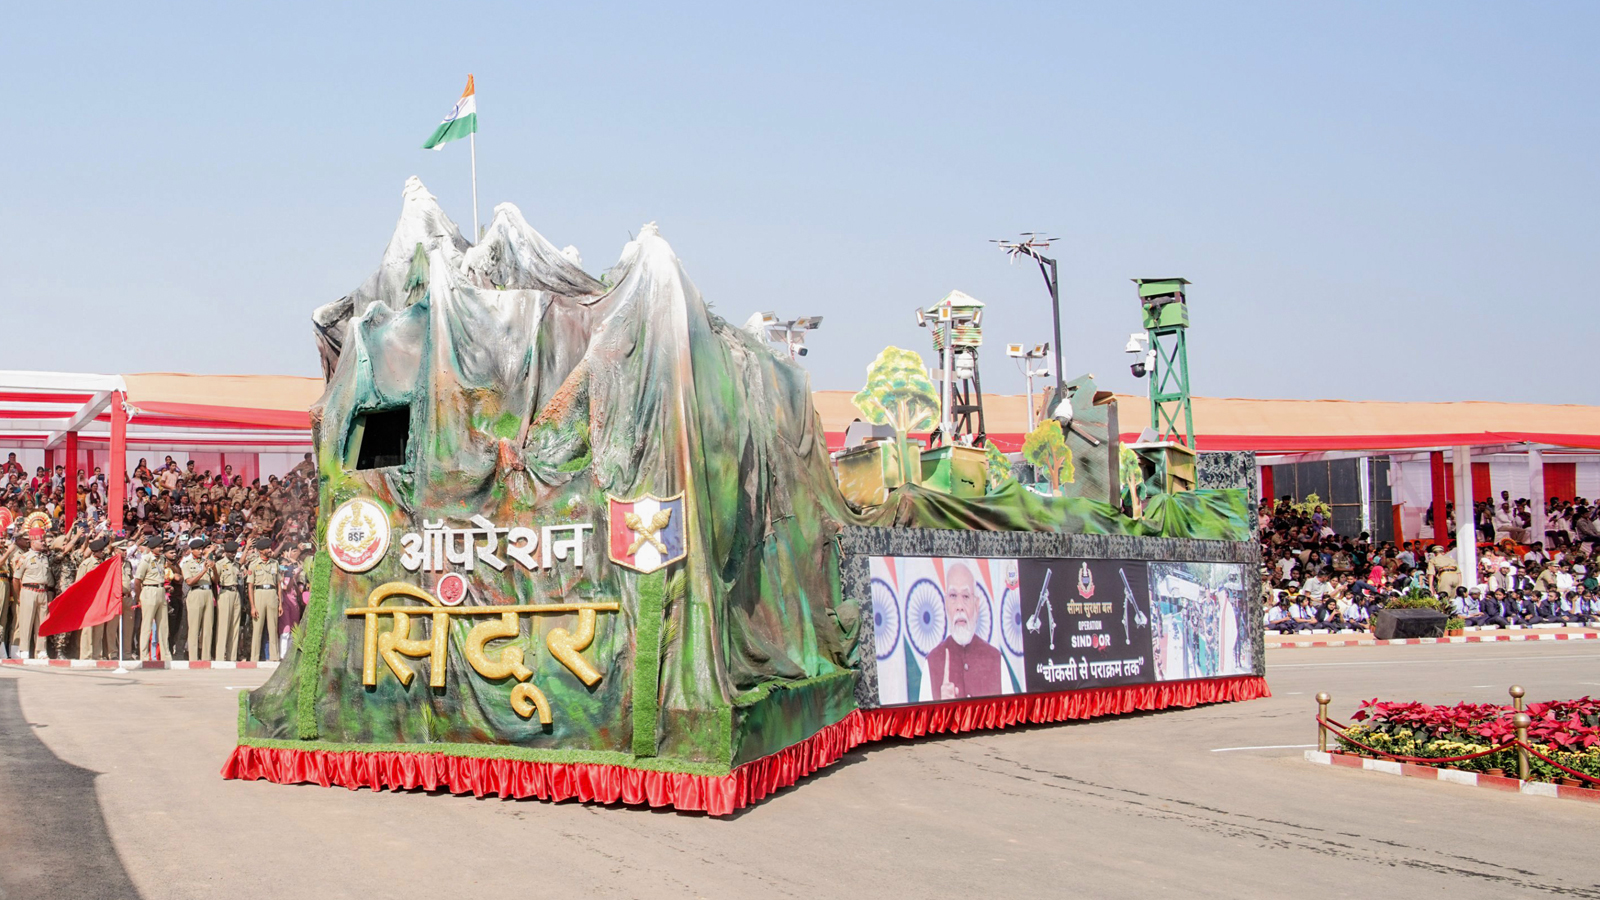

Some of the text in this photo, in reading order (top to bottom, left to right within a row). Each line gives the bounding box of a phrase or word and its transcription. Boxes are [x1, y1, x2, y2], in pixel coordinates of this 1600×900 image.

[348, 532, 365, 542] BSF
[400, 514, 592, 571] ऑपरेशन
[1067, 599, 1083, 614] सीमा
[1084, 602, 1101, 618] सुरक्षा
[1078, 620, 1102, 630] OPERATION
[344, 572, 619, 724] सिंदूर
[1079, 655, 1089, 680] से
[1090, 660, 1122, 679] पराक्रम
